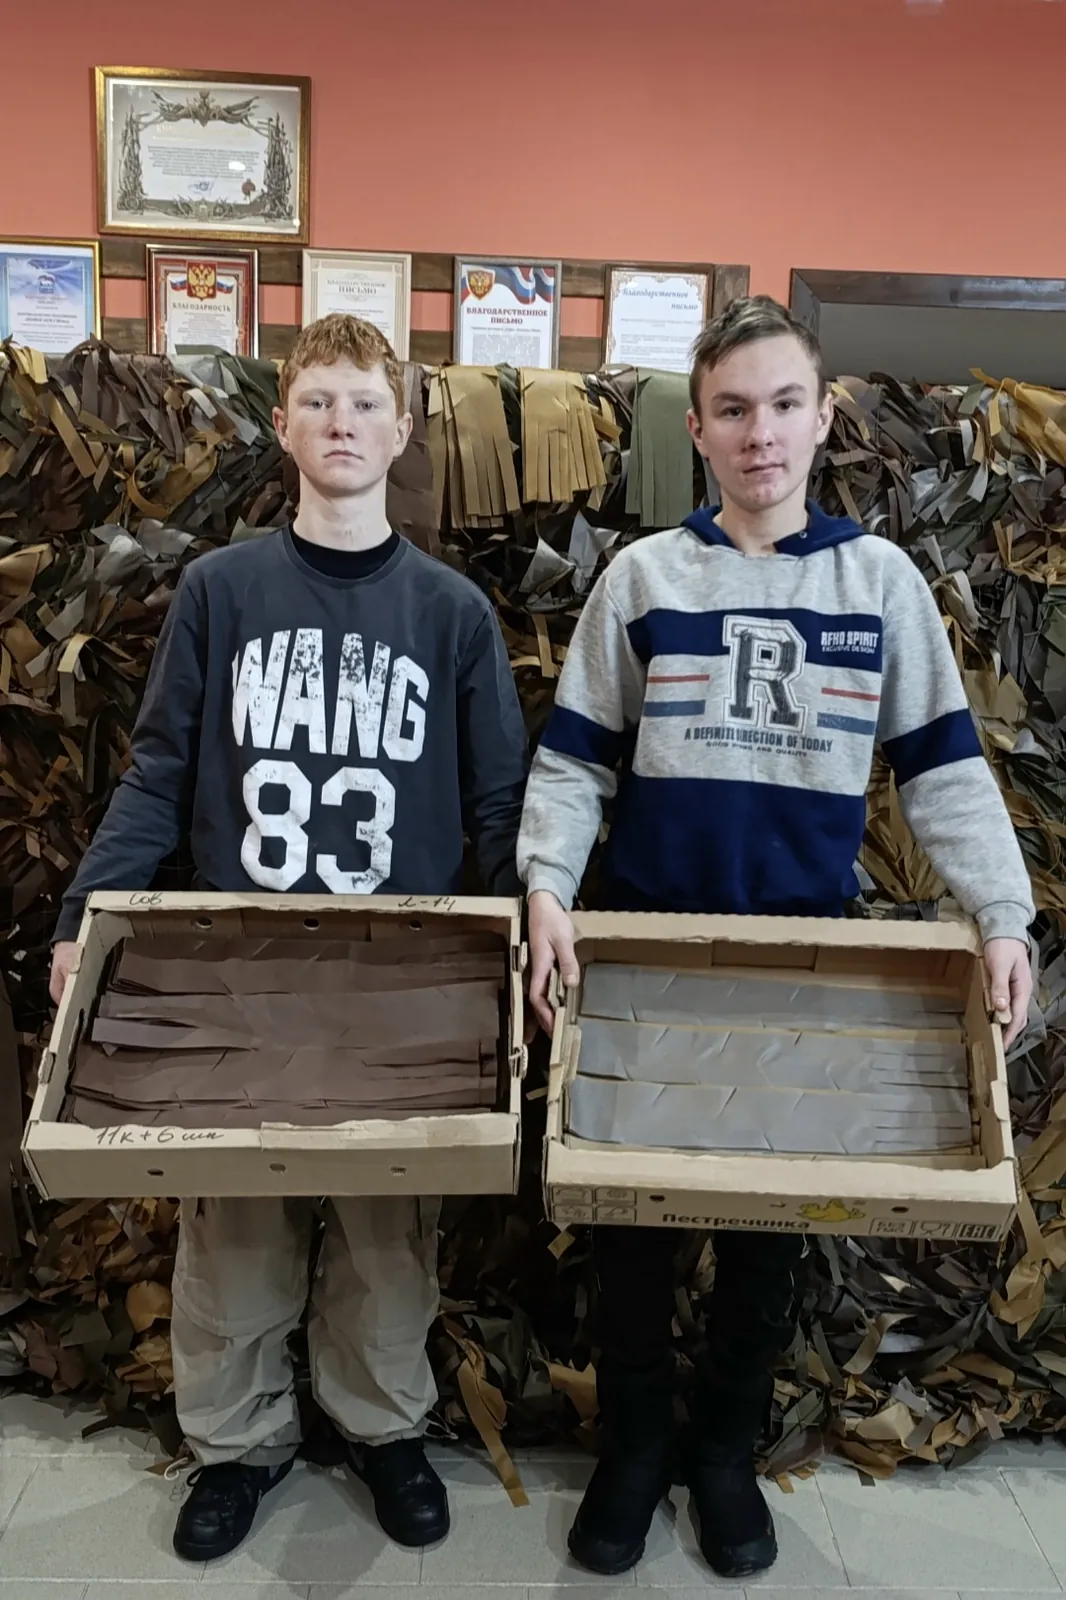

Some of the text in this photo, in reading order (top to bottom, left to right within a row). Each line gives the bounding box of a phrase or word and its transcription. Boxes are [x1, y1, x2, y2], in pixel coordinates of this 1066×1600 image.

[172, 302, 231, 312] БЛАГОДАРНОСТЬ
[466, 307, 548, 316] БЛАГОДАРСТВЕННОЕ
[846, 631, 879, 648] SPIRIT
[722, 614, 808, 735] R
[231, 627, 430, 763] WANG
[684, 727, 692, 741] A
[786, 735, 799, 749] OF
[801, 736, 834, 753] TODAY
[240, 758, 396, 895] 83
[662, 1212, 810, 1229] Пестречинка
